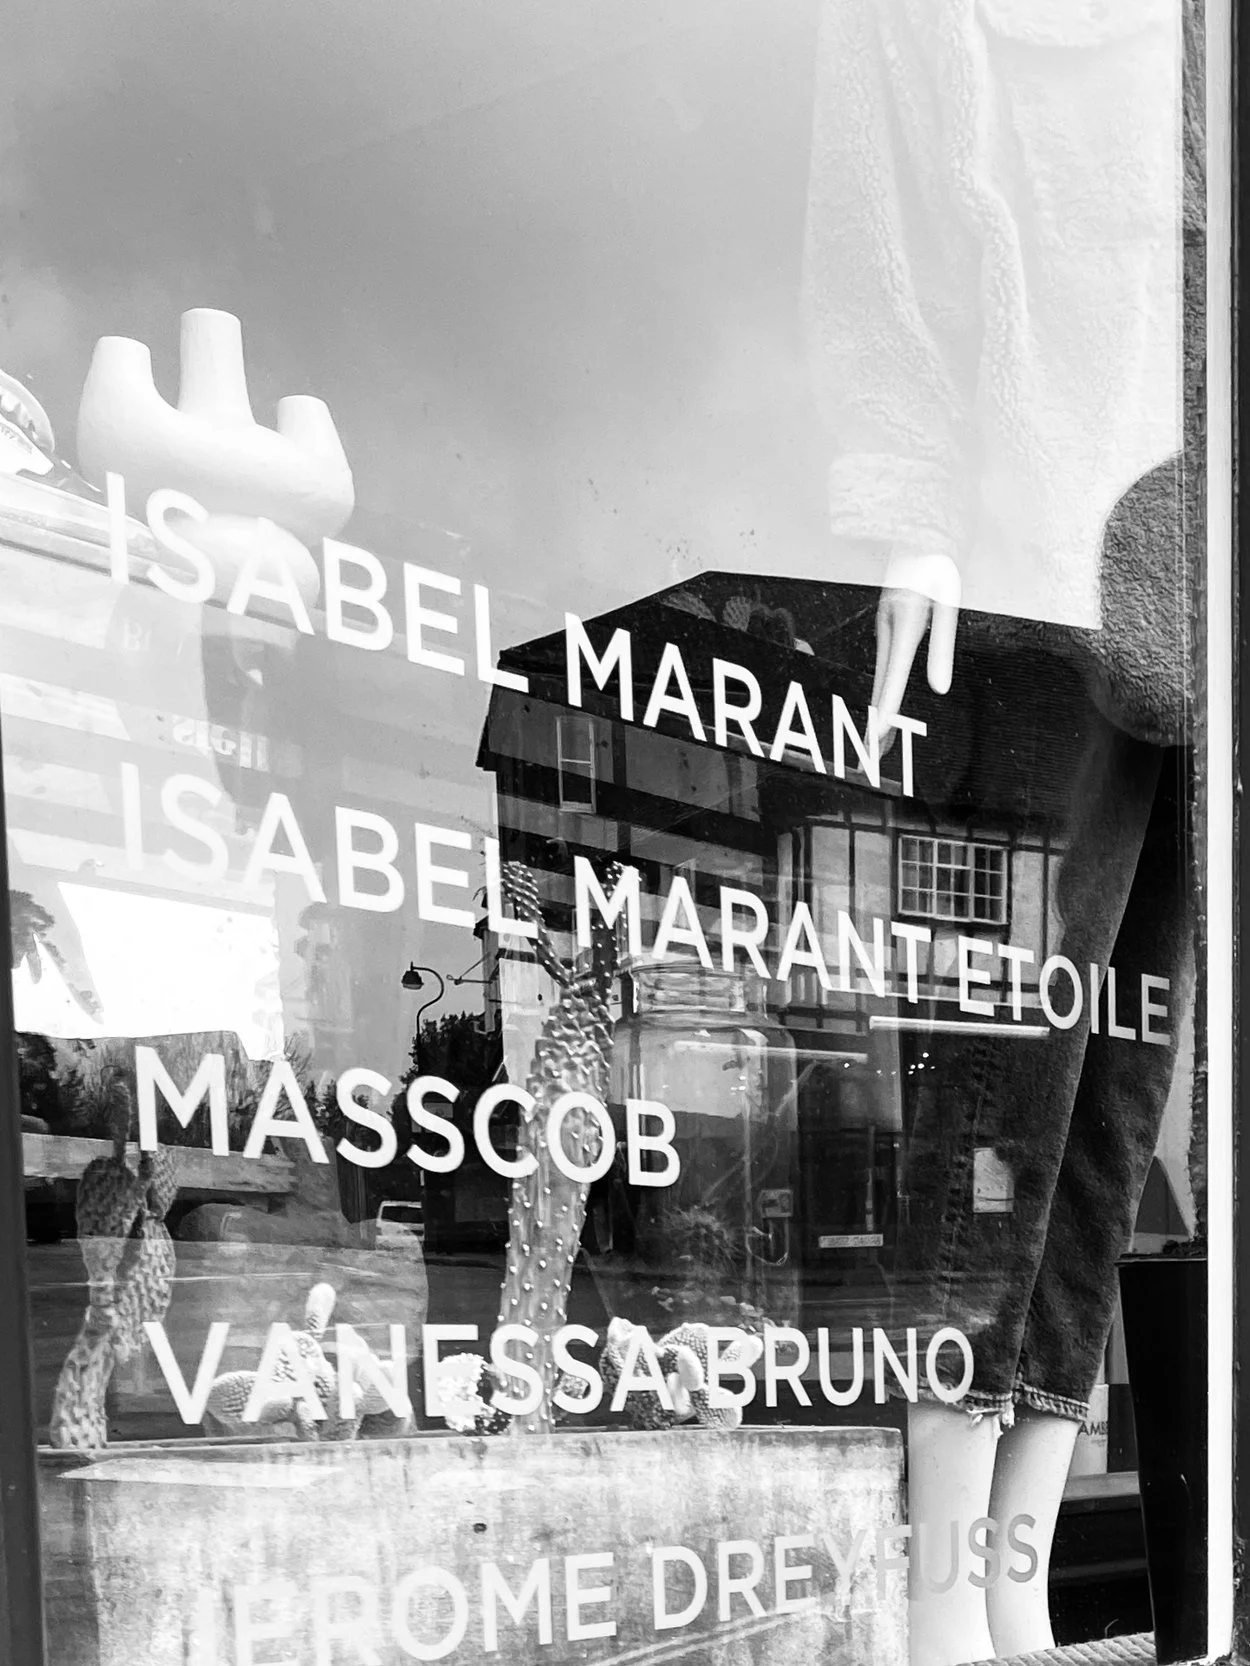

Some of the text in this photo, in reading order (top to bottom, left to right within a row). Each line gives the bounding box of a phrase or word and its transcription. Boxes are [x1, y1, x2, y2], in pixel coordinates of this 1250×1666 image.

[105, 470, 928, 798] ISABEL MARANT
[119, 760, 1172, 1046] ISABEL MARANT ETOILE
[134, 1045, 682, 1188] MASSCOB
[142, 1320, 976, 1425] VANESSA BRUNO
[651, 1513, 1039, 1632] DREYFUSS
